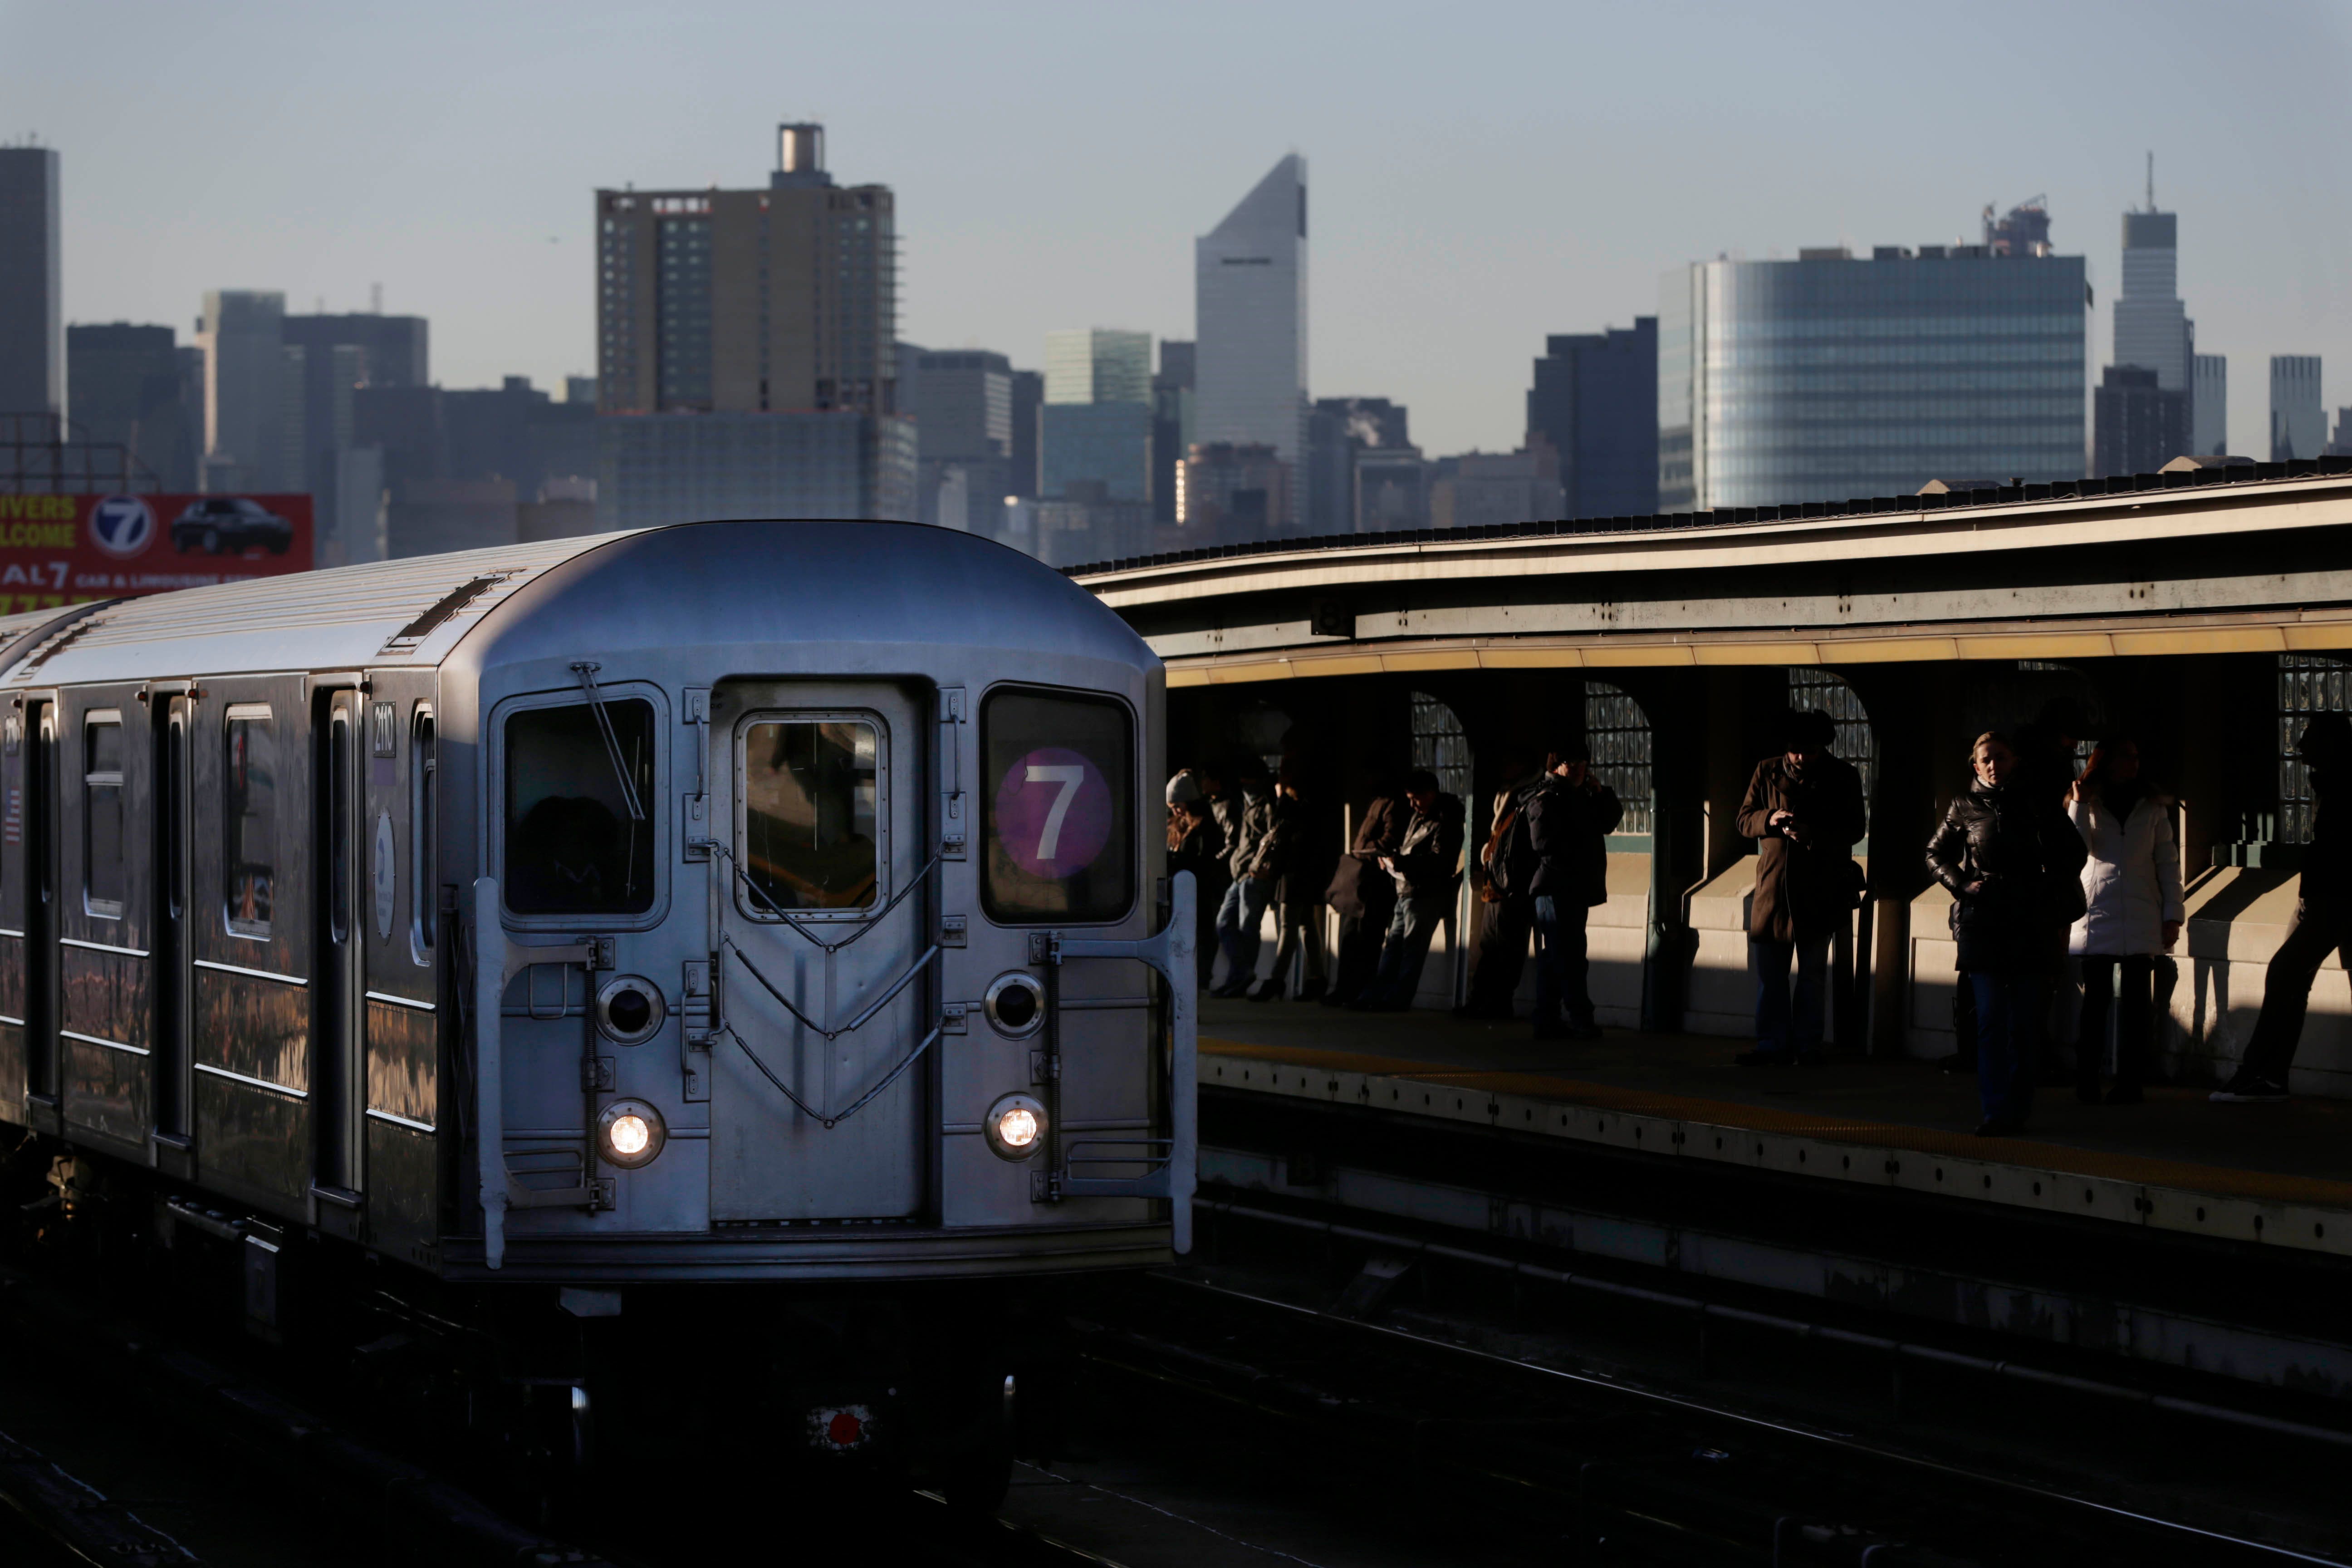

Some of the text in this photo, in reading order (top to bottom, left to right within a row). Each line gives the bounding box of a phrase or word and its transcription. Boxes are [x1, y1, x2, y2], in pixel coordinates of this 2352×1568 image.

[101, 503, 142, 547] 7
[47, 561, 70, 589] 7
[75, 574, 109, 588] CAR
[375, 705, 393, 751] 2110
[1025, 765, 1084, 859] 7
